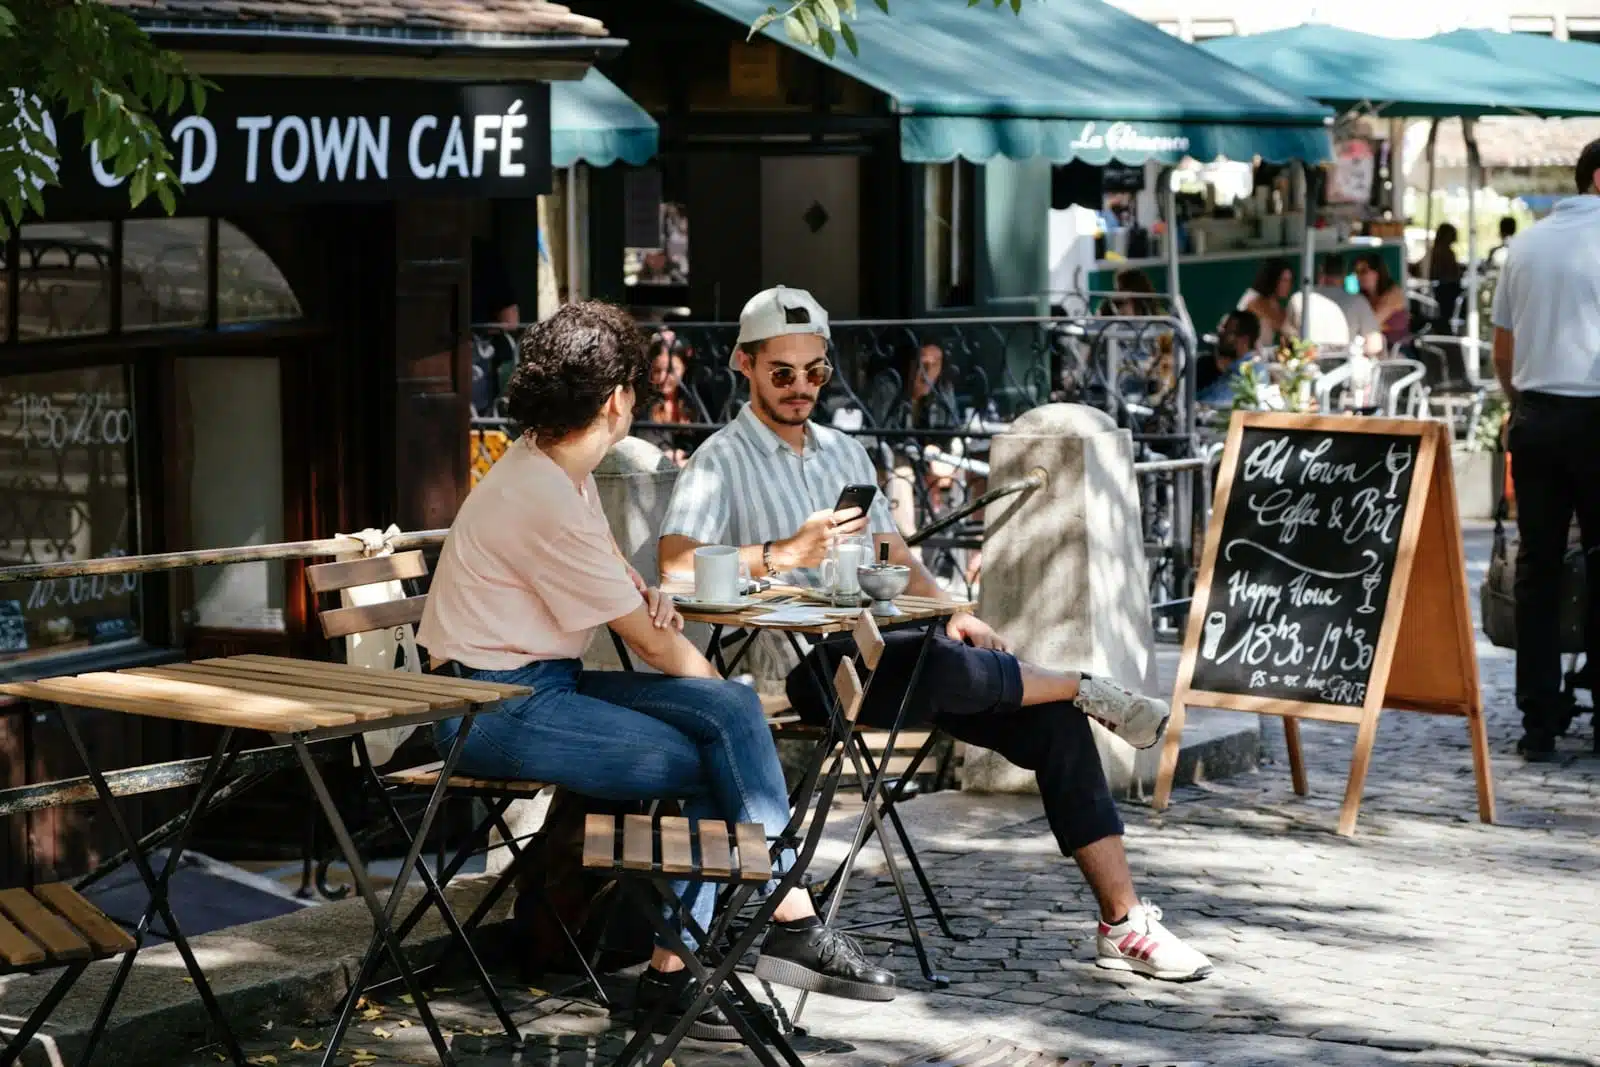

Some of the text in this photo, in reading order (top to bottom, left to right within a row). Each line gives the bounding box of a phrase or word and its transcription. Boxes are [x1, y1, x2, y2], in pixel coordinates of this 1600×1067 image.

[237, 115, 390, 184] TOWN
[408, 99, 528, 179] CAFÉ
[1244, 435, 1382, 485] Old Town
[1248, 487, 1401, 545] Coffee & Bar
[1228, 569, 1283, 622] Happy
